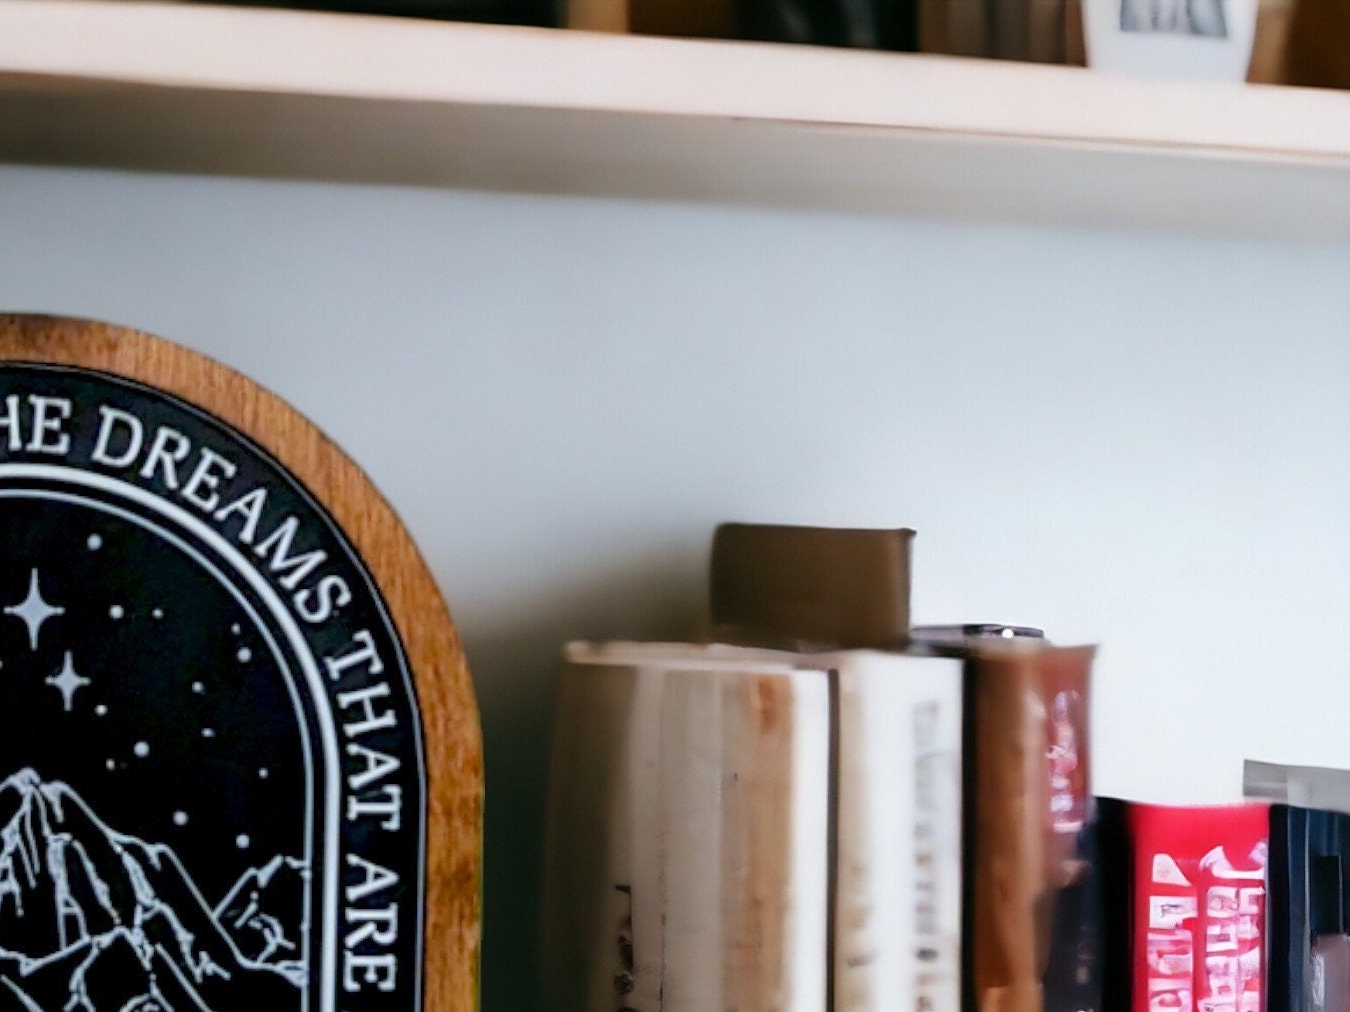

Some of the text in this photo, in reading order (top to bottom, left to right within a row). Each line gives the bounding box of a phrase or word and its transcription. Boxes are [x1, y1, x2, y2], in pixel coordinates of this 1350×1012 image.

[91, 405, 351, 626] DREAMS
[323, 629, 401, 832] THAT
[343, 854, 400, 993] ARE
